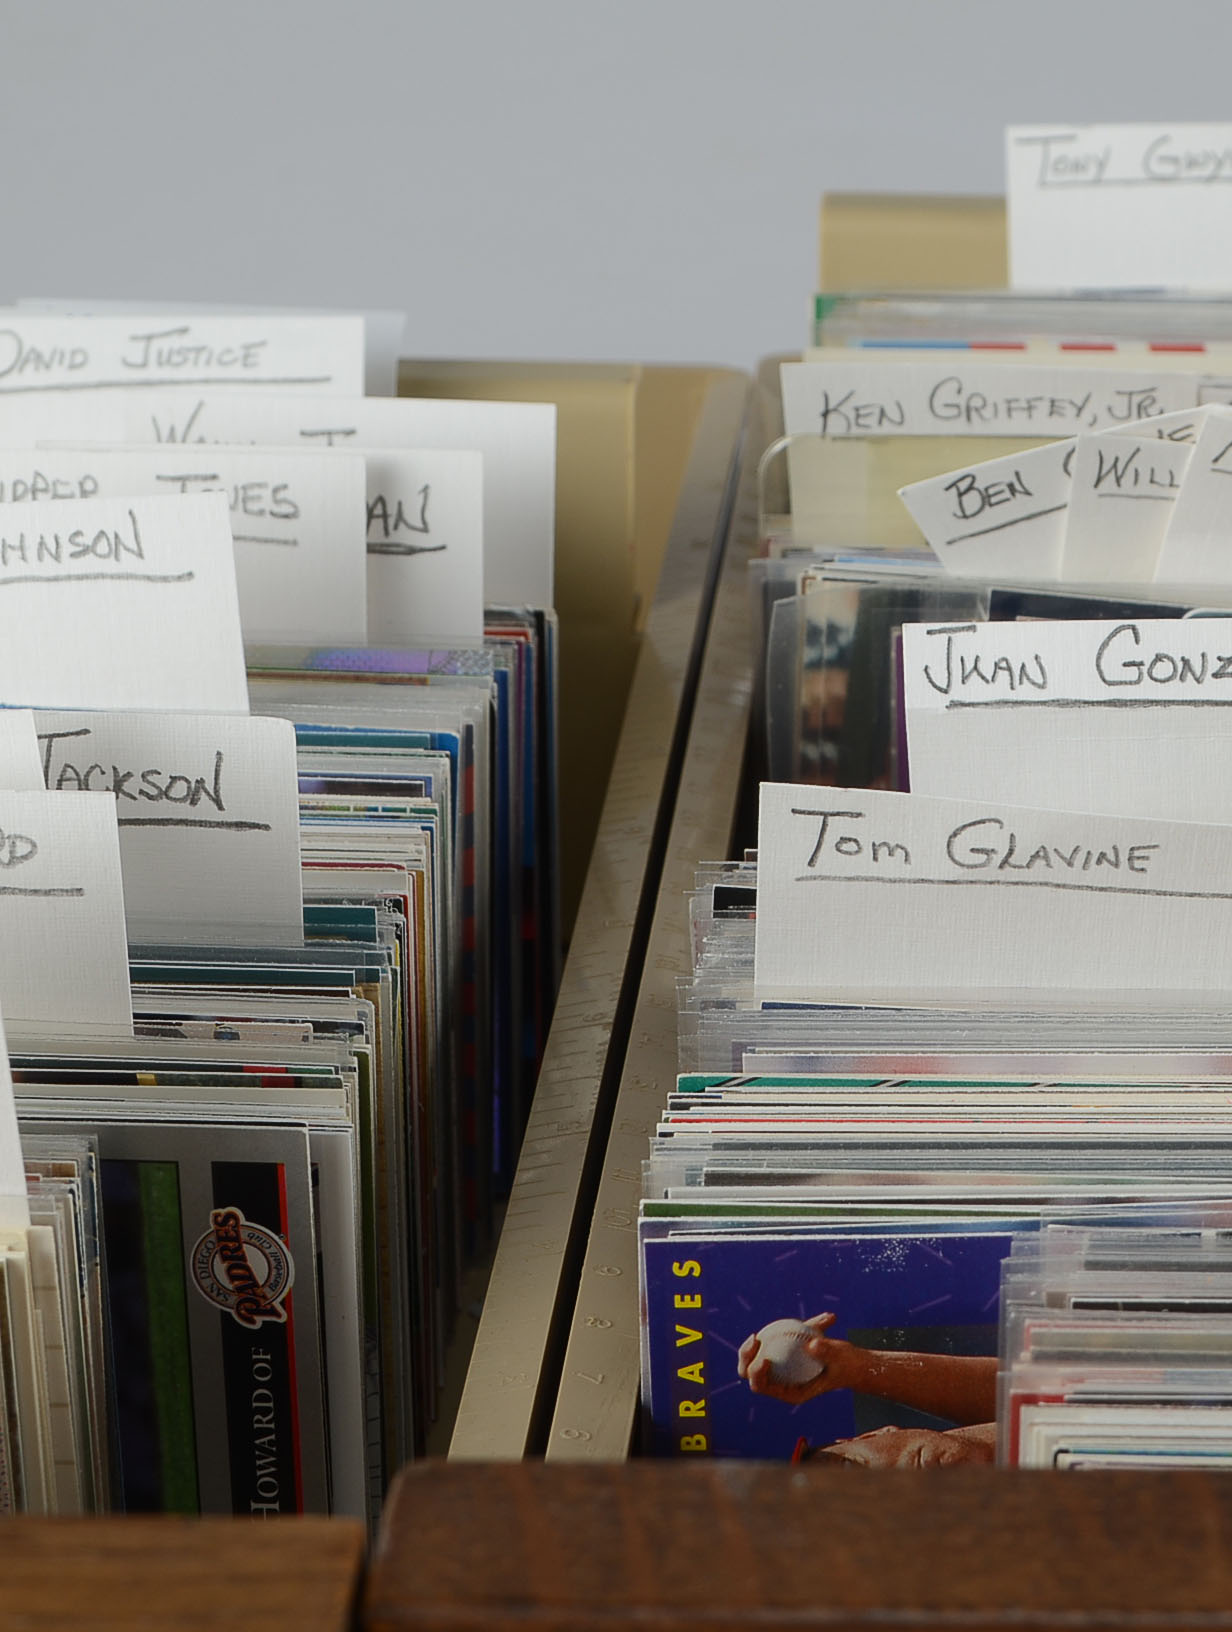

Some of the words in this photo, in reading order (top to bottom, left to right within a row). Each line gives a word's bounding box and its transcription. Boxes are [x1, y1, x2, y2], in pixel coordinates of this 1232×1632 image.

[122, 326, 268, 370] JUSTICE
[819, 390, 906, 440] KEN
[944, 471, 1034, 520] BEN
[923, 625, 1049, 694] JUAN
[946, 818, 1161, 873] GLAVINE
[251, 1346, 272, 1381] OF
[672, 1259, 710, 1454] BRAVES
